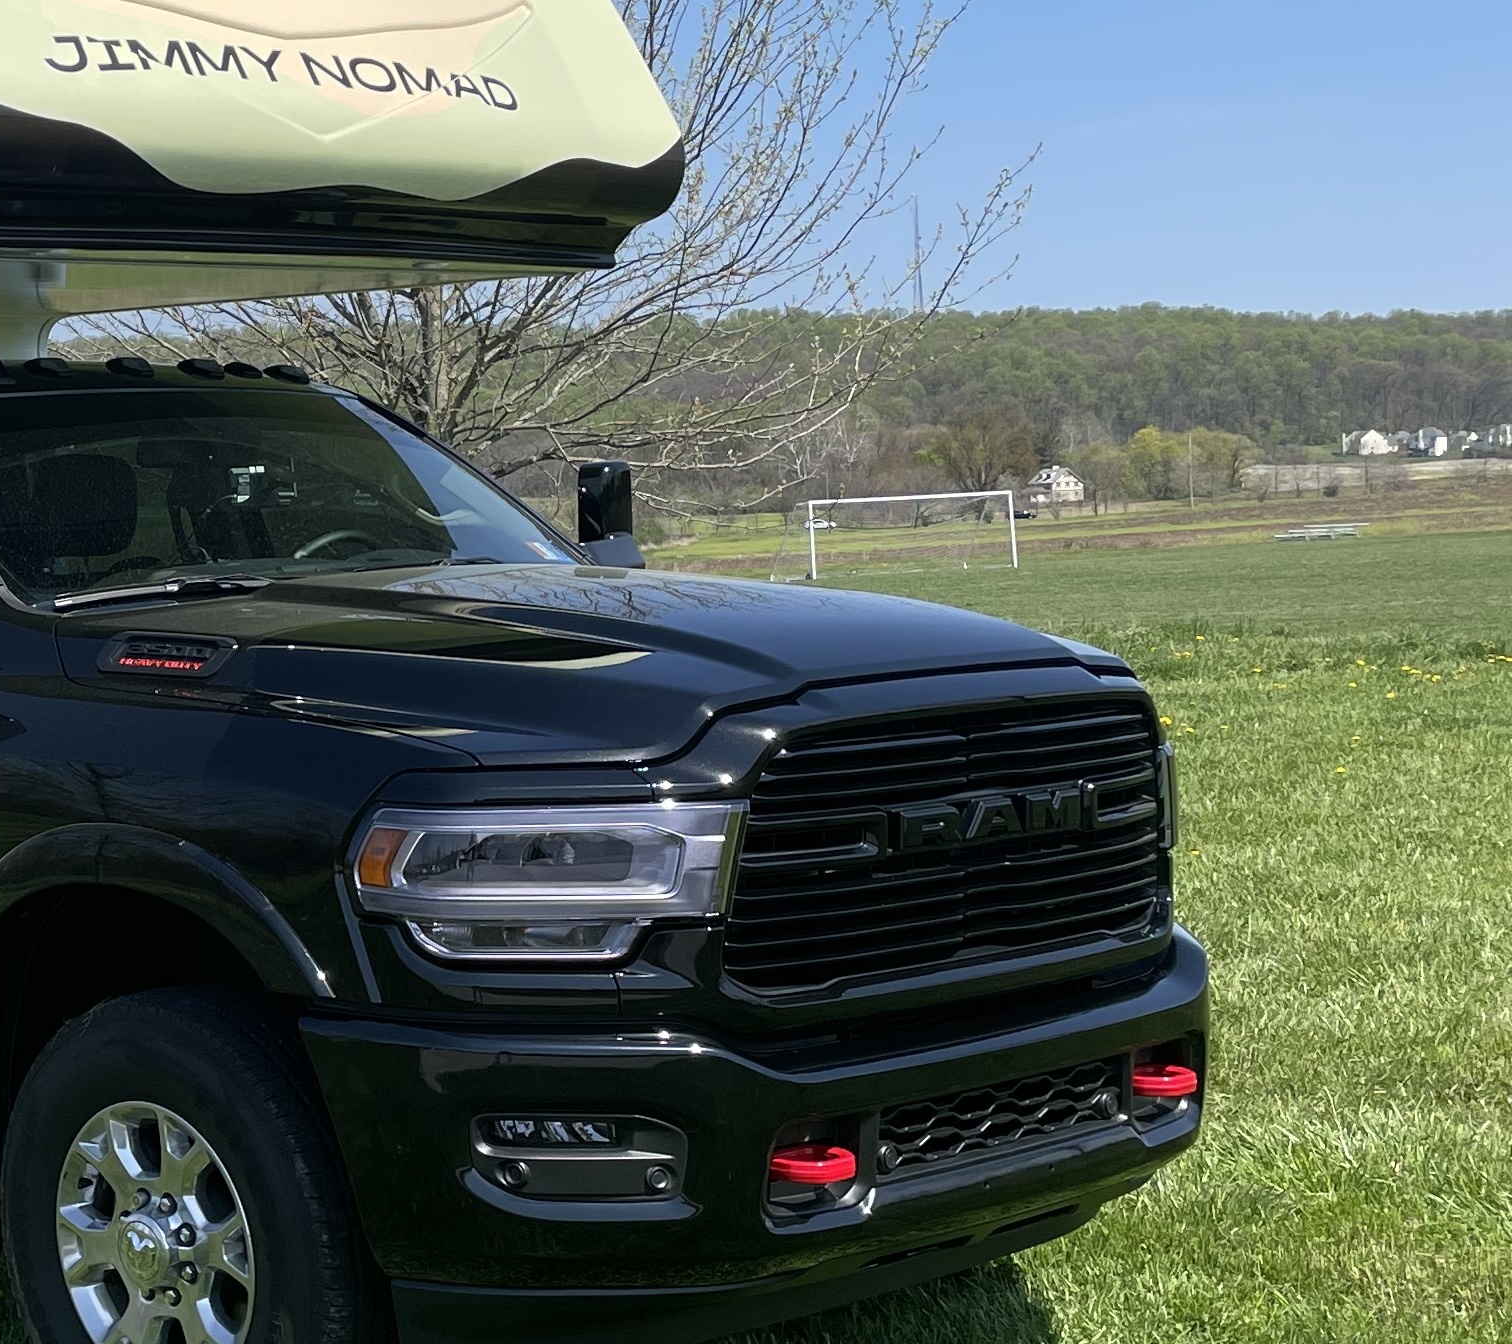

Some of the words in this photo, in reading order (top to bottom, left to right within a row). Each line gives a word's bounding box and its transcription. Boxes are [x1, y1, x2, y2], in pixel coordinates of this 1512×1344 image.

[43, 35, 283, 83] JIMMY
[300, 51, 519, 112] NOMAD
[896, 786, 1082, 851] RAM
